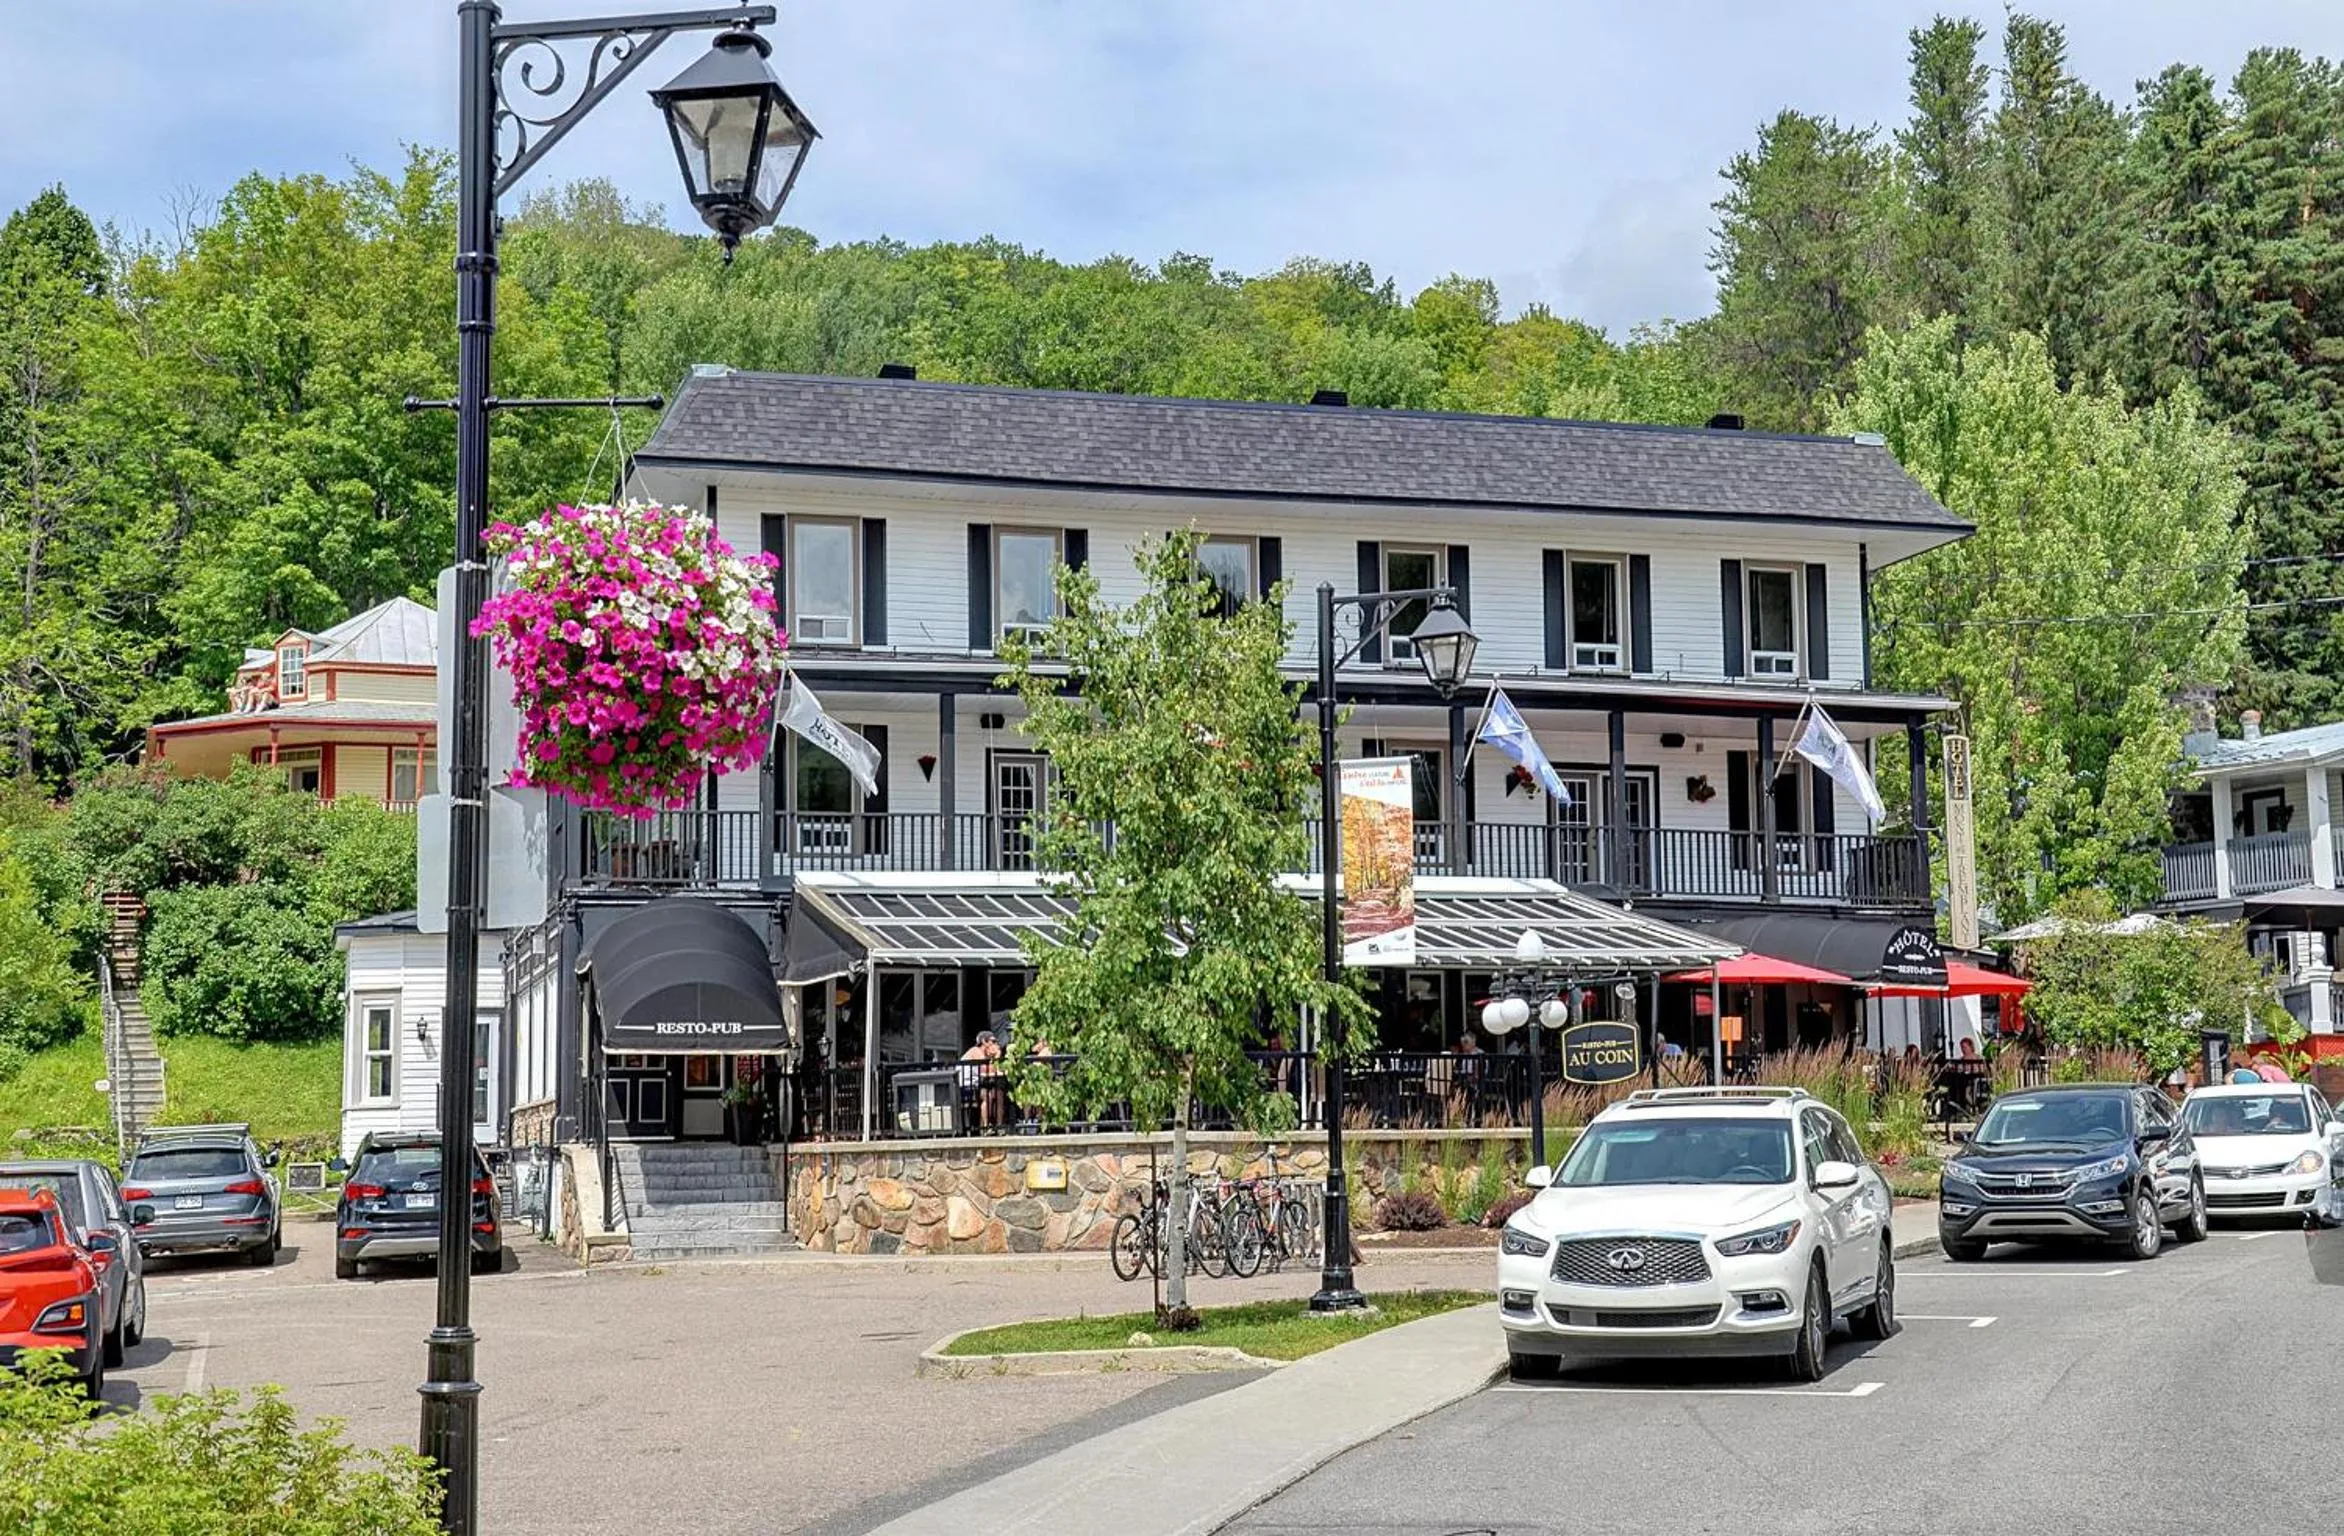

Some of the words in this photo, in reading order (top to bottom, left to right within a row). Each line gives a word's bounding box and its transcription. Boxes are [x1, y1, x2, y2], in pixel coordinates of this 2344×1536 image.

[1893, 929, 1934, 958] HÔTEL
[655, 1022, 742, 1034] RESTO-PUB
[1568, 1051, 1591, 1067] AU
[1595, 1049, 1633, 1065] COIN
